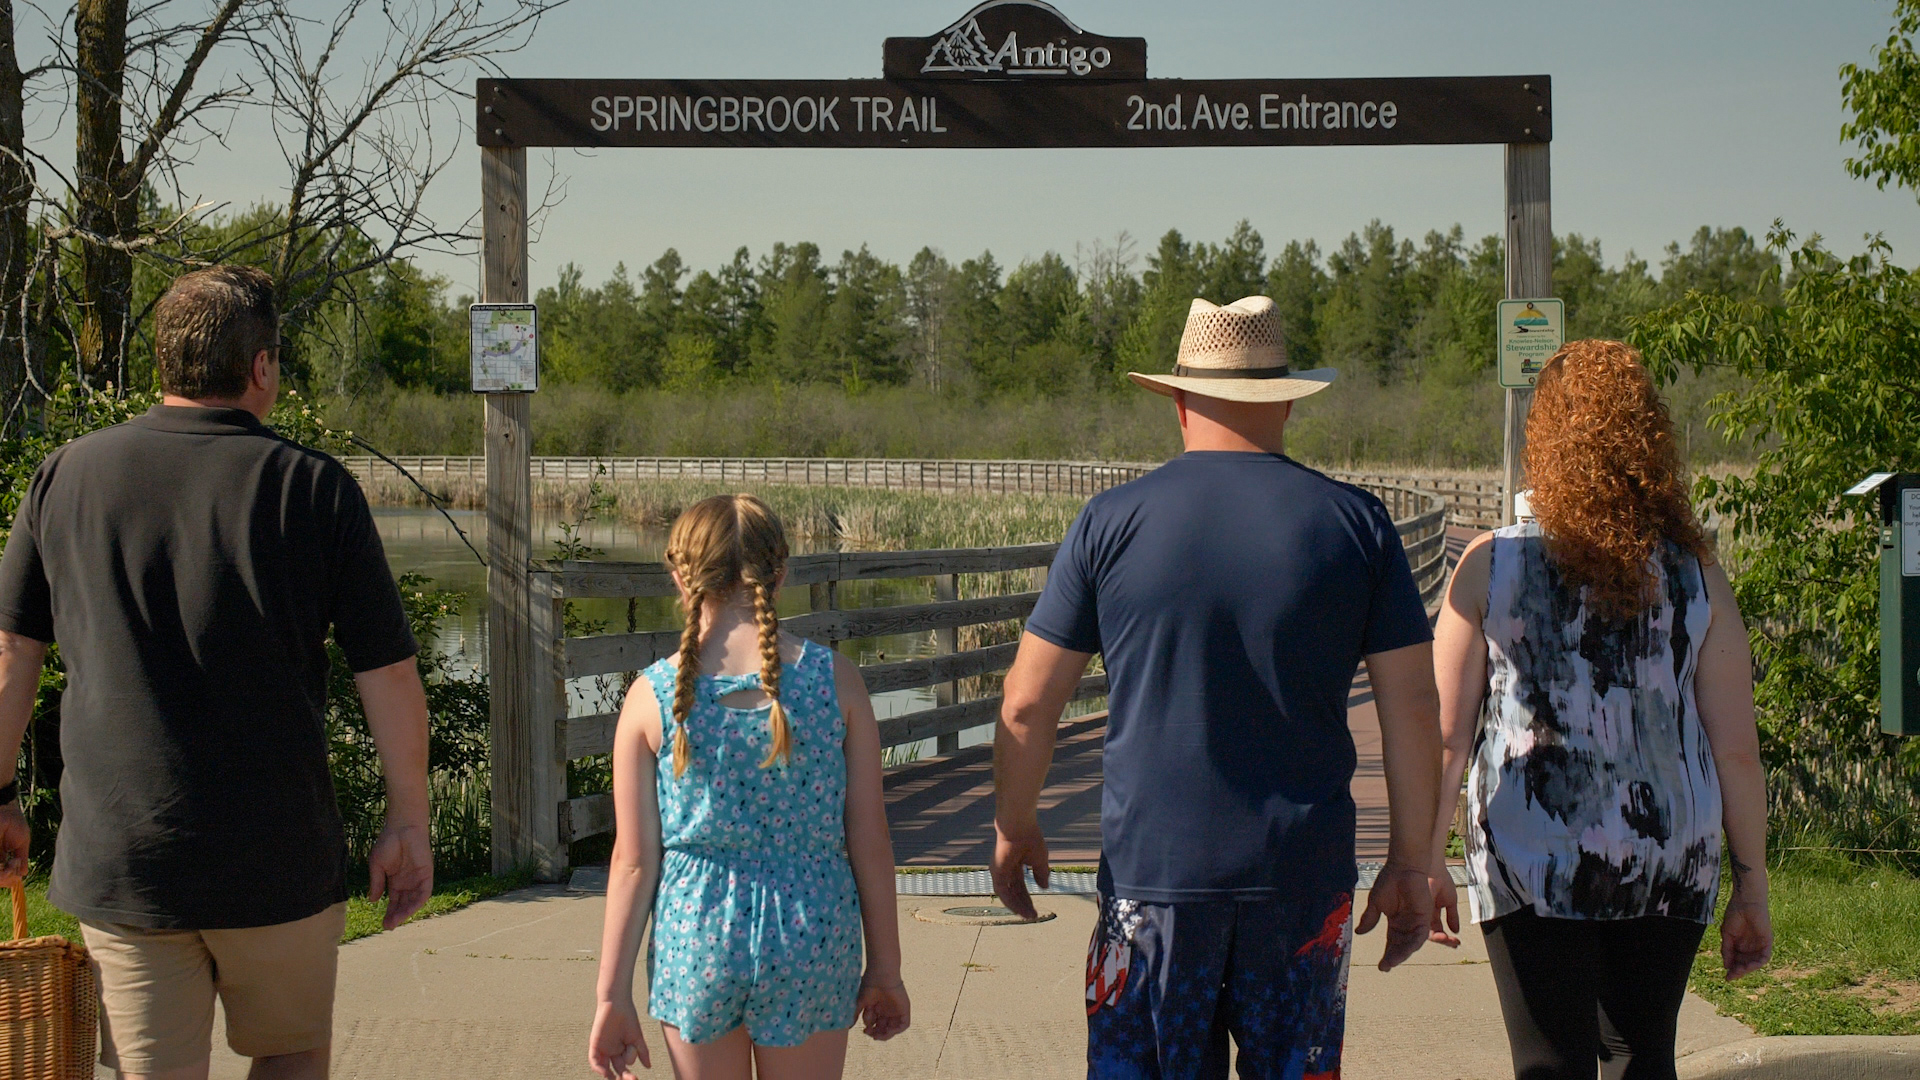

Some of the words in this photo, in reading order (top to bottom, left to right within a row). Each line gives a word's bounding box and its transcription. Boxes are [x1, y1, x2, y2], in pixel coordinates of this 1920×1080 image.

[992, 31, 1111, 76] Antigo
[590, 96, 840, 132] SPRINGBROOK
[850, 96, 948, 133] TRAIL
[1126, 94, 1187, 130] 2nd.
[1191, 94, 1254, 130] Ave.
[1260, 93, 1398, 130] Entrance
[1506, 343, 1557, 352] Stewardship
